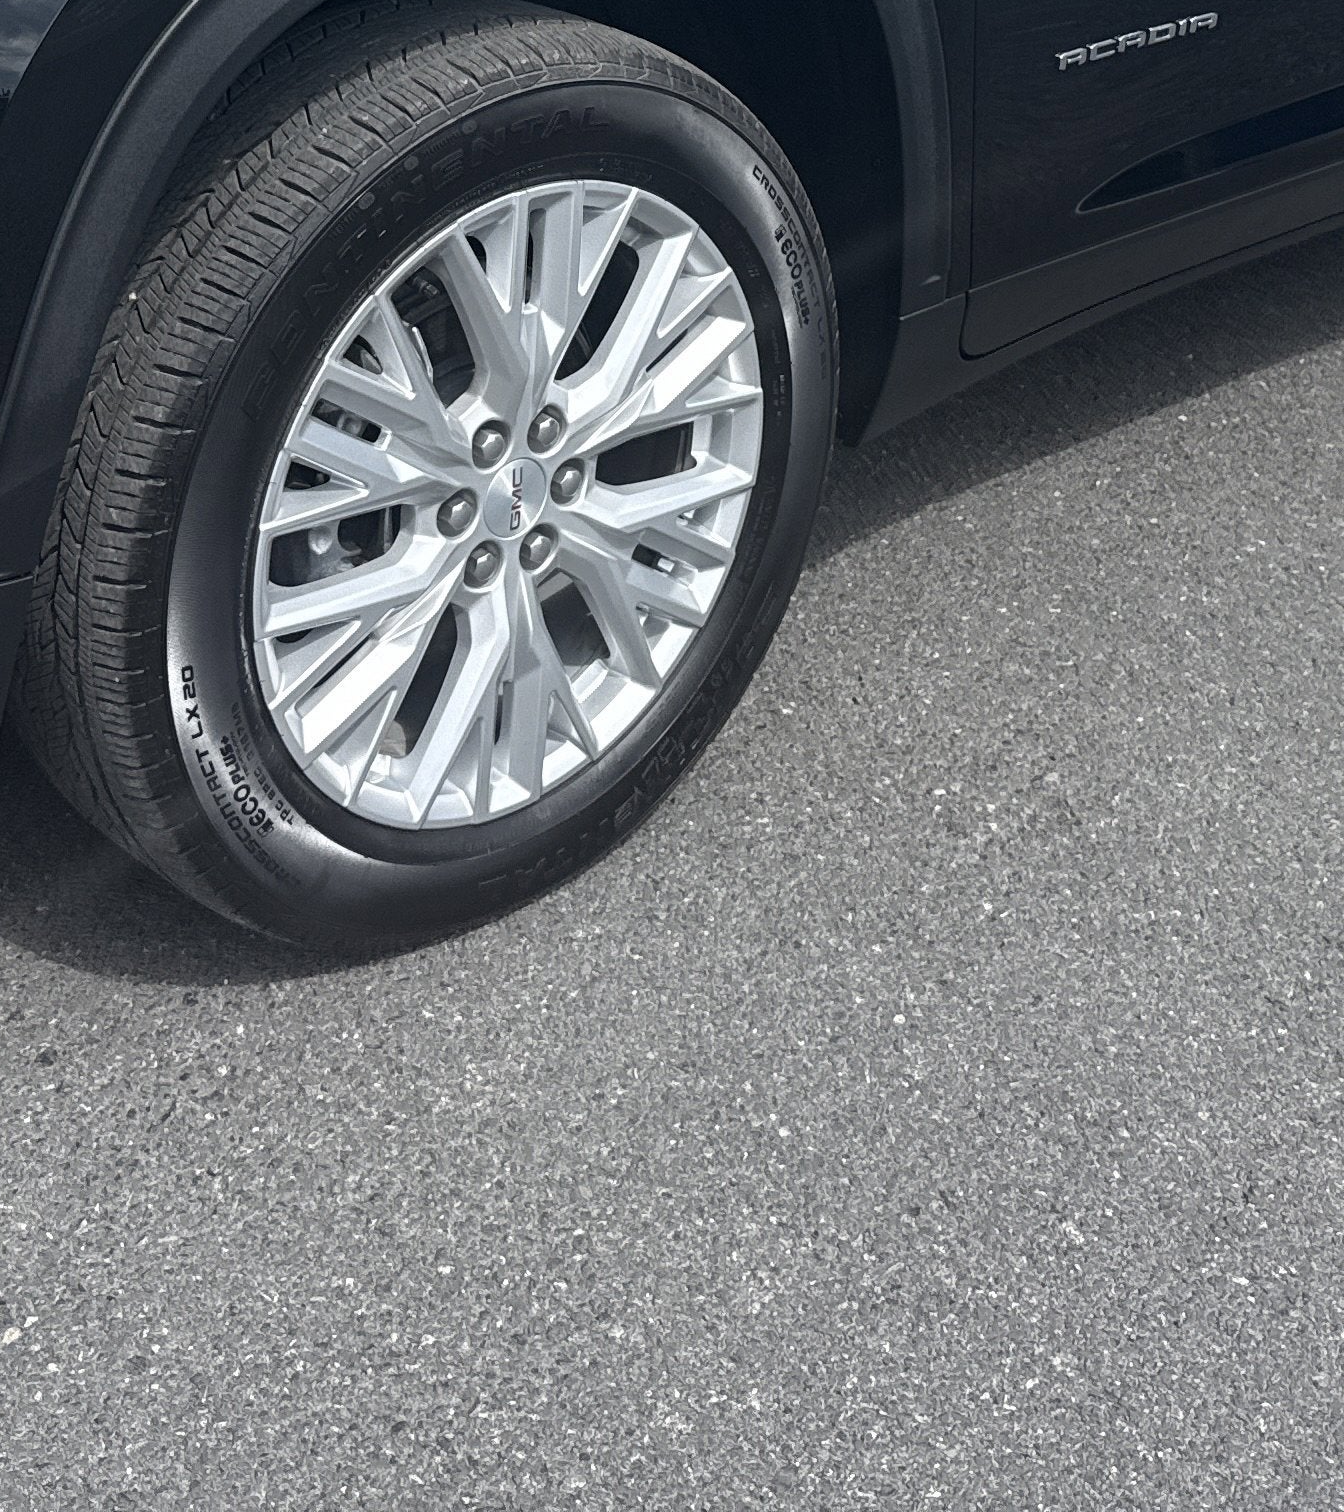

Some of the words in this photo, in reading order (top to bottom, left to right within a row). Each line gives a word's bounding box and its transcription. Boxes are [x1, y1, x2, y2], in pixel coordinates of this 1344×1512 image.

[1055, 11, 1219, 71] ACADIA
[509, 466, 524, 531] GMC
[181, 665, 197, 700] 20
[185, 703, 204, 739] LX
[275, 799, 295, 825] TPC
